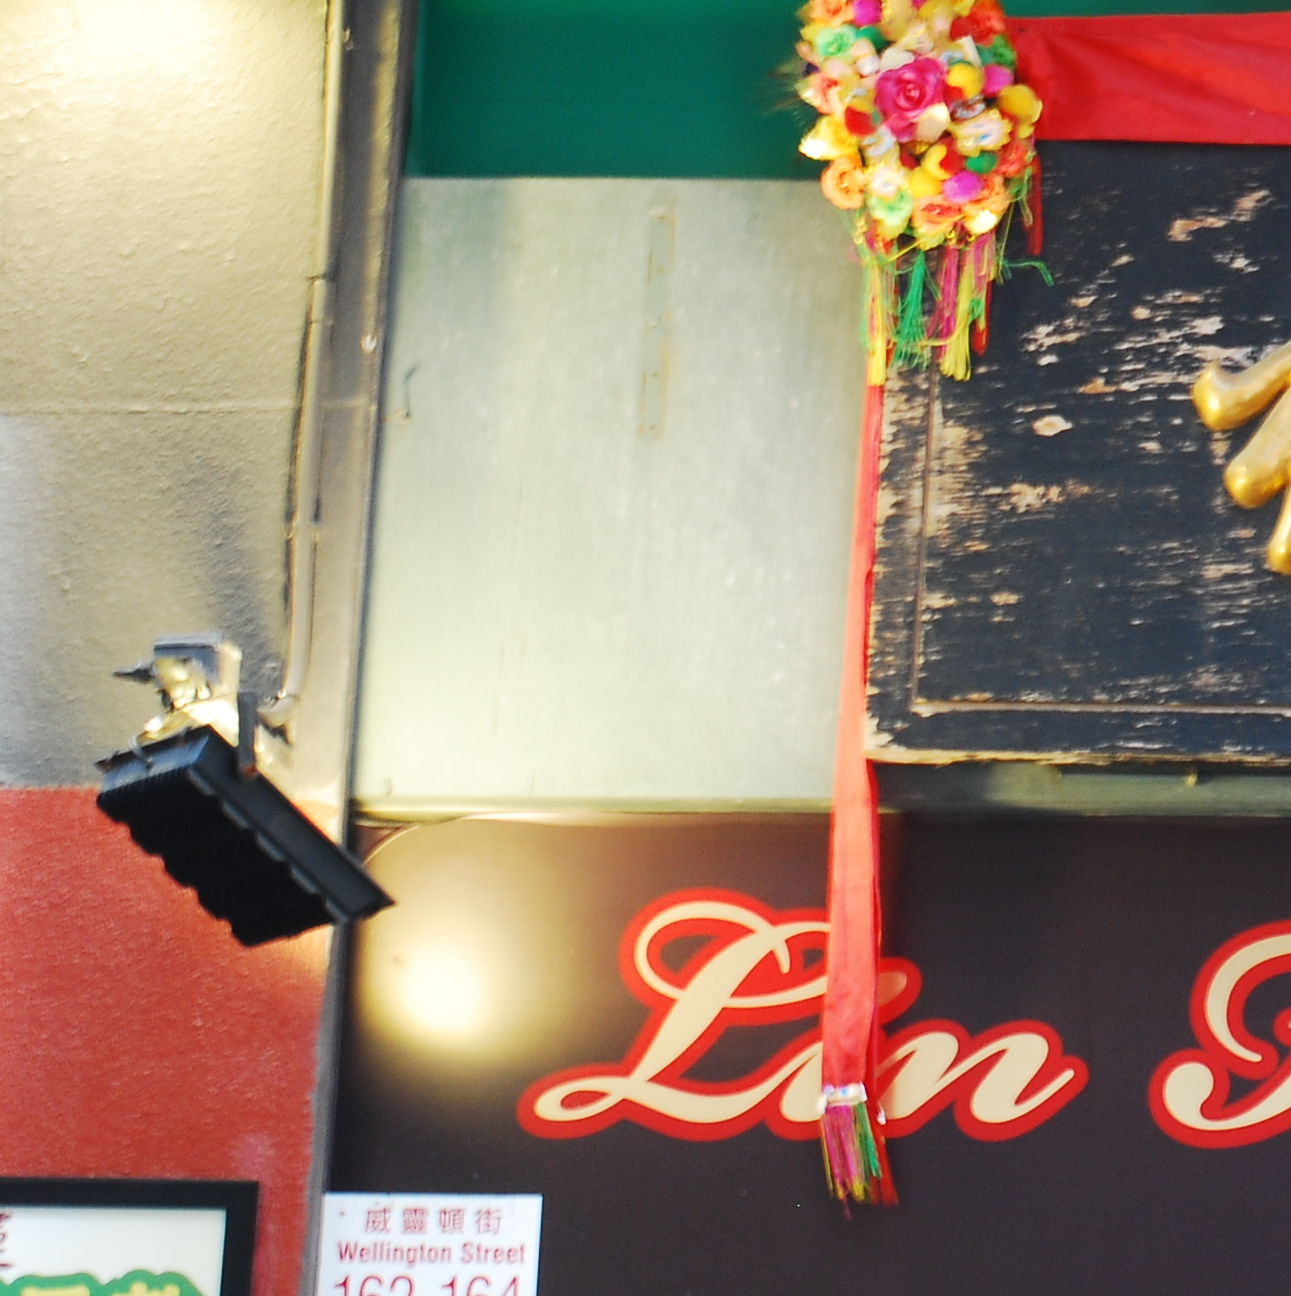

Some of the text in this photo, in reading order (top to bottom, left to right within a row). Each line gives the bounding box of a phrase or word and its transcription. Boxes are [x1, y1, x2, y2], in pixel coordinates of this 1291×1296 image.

[365, 1207, 503, 1235] 威靈頓街
[337, 1241, 526, 1268] Wellington Street
